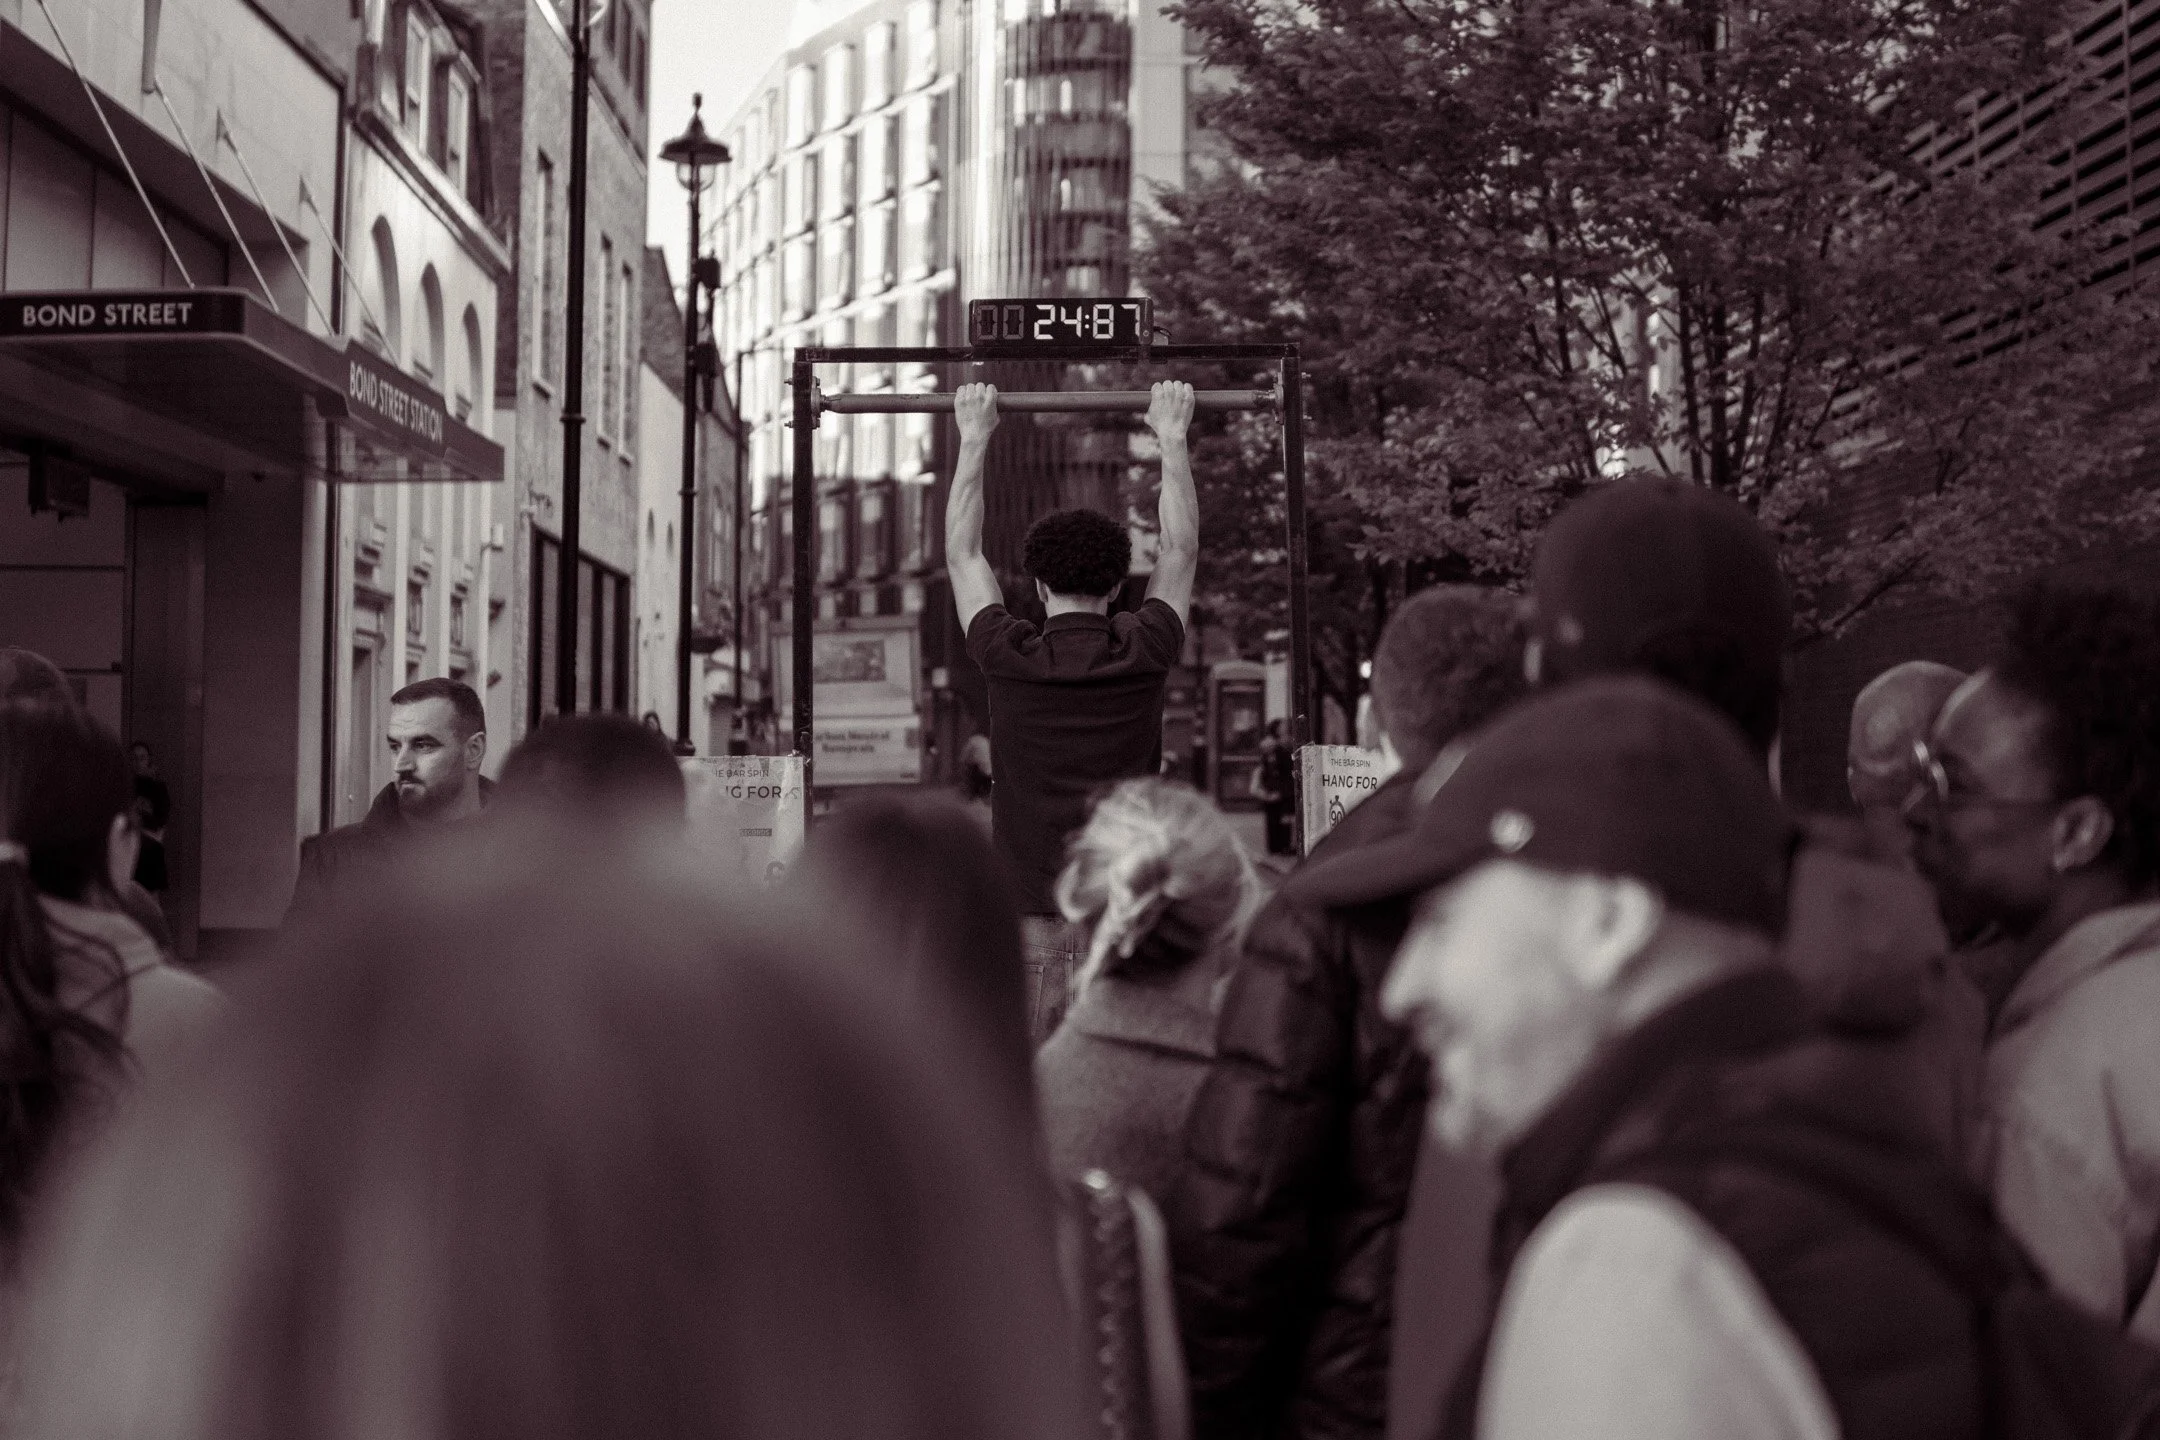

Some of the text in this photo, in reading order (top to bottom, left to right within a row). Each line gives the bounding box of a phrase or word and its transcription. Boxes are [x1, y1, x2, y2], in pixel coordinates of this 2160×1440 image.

[22, 302, 193, 327] BOND STREET
[1033, 303, 1141, 340] 24:87
[349, 360, 443, 444] BOND STREET STATION
[1330, 758, 1371, 768] THE BAR SPIN
[726, 769, 746, 778] BAR
[747, 769, 770, 778] SPIN
[1321, 773, 1378, 790] HANG FOR
[747, 785, 782, 799] FOR
